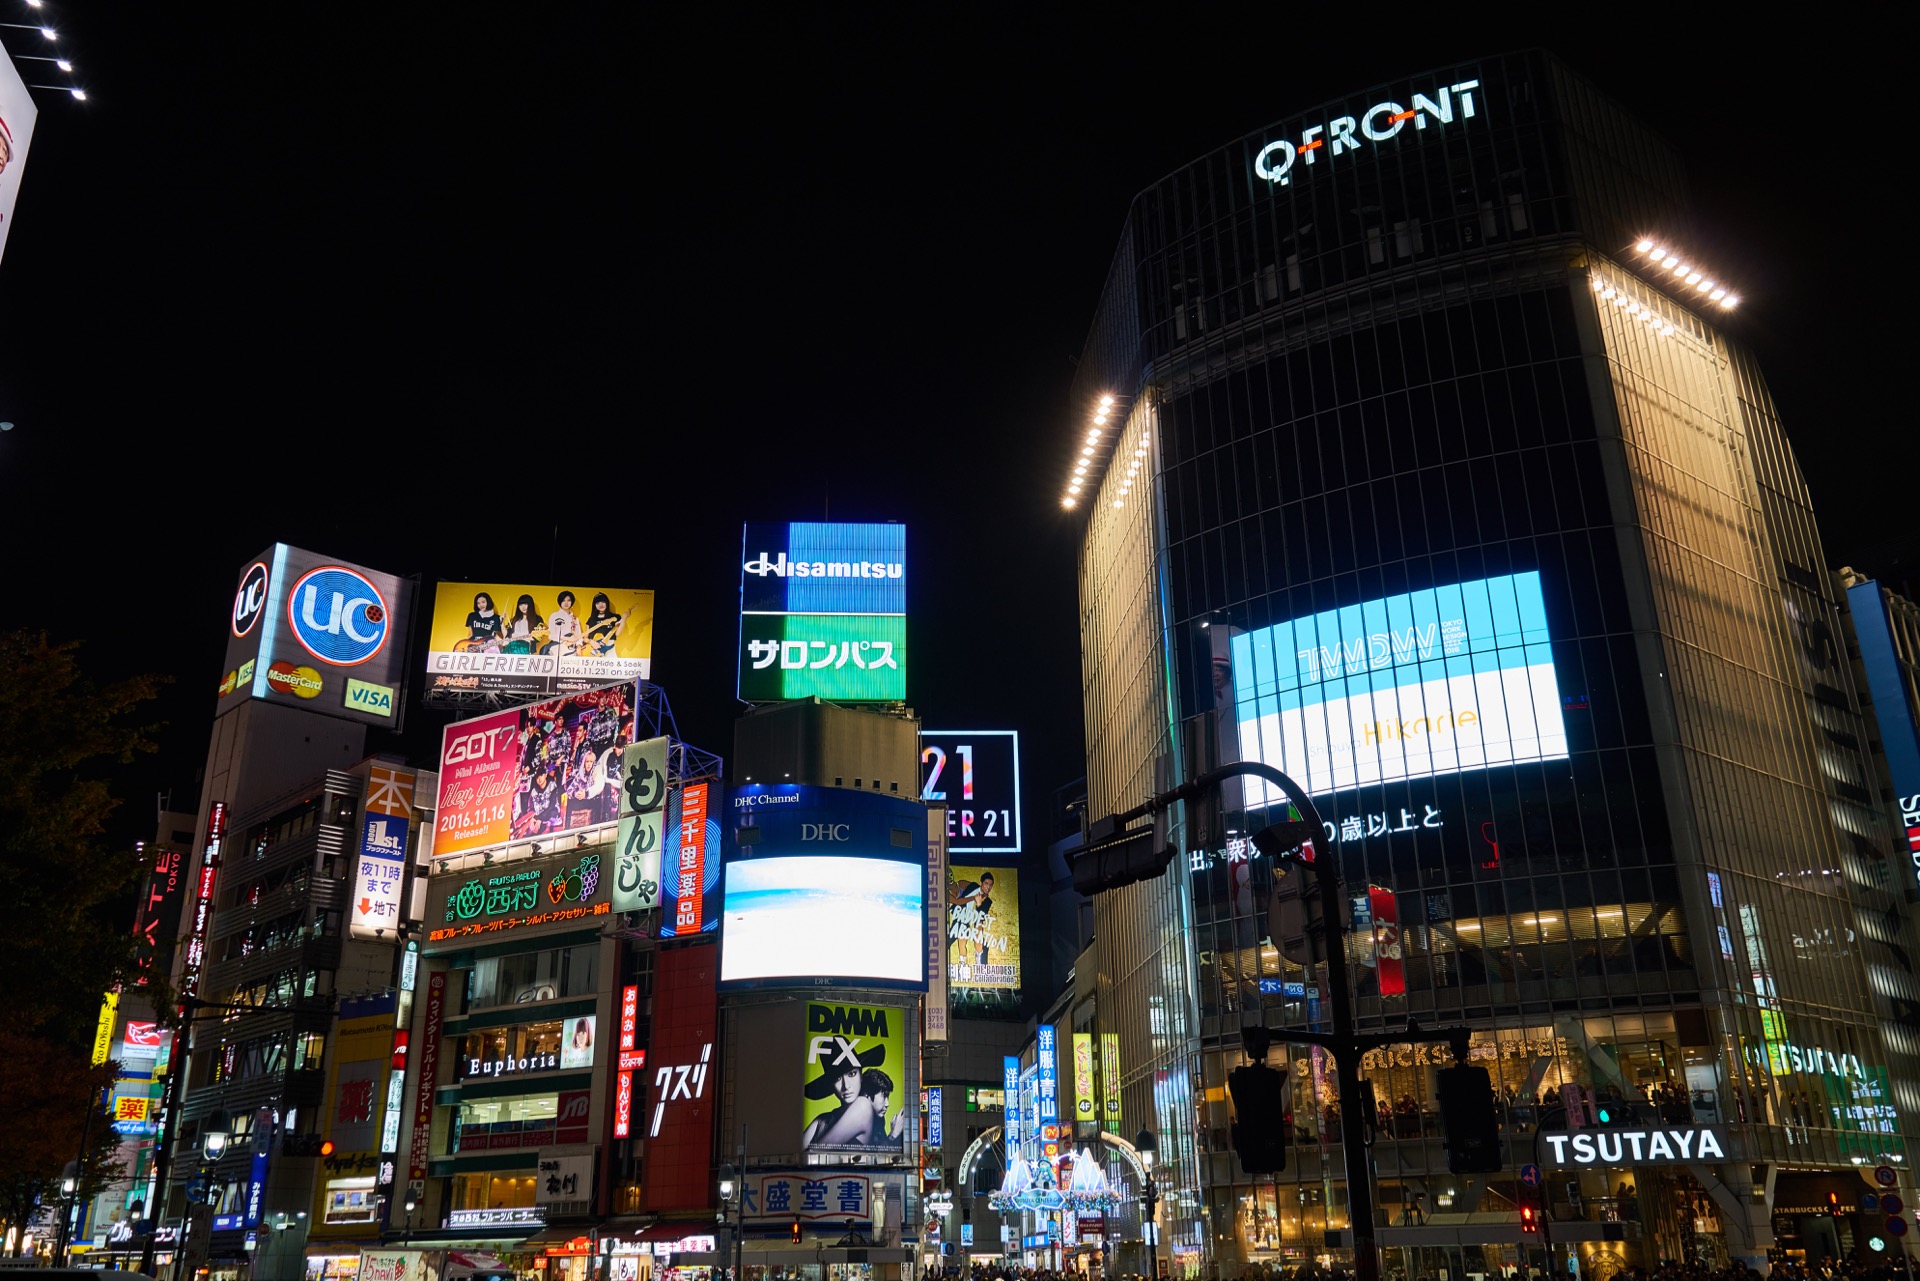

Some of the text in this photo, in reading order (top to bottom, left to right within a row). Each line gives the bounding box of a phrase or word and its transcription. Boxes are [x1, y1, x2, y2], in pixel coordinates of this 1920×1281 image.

[1254, 79, 1479, 186] QFRONT
[744, 552, 902, 578] Hisamitsu
[1441, 619, 1463, 628] OKYO
[436, 655, 554, 673] GIRLFRIEND
[748, 639, 897, 670] サロンパス
[1298, 622, 1436, 682] TWDW
[239, 664, 253, 680] VISA
[268, 669, 323, 690] MasterCard
[560, 667, 606, 675] 2016.11.23
[624, 668, 642, 676] sale
[352, 688, 391, 709] VISA
[1364, 708, 1477, 747] Hikarie
[444, 727, 516, 765] GOT7
[455, 761, 500, 780] Mini Album
[920, 745, 974, 800] 21
[366, 770, 413, 815] 本
[440, 770, 511, 810] Hey Yah
[734, 793, 800, 808] DHC Channel
[440, 804, 506, 833] 2016.11.16
[617, 757, 664, 904] もんじゃ
[984, 810, 1010, 837] 21
[367, 822, 376, 843] BOOK
[454, 824, 489, 841] Release!!
[801, 824, 850, 842] DHC
[366, 845, 402, 856] ブックファースト
[677, 790, 701, 926] 三千里薬品
[166, 853, 181, 893] TOKYO
[361, 862, 401, 881] 夜11時
[489, 870, 541, 886] FRUITS&PARLOR
[367, 878, 392, 895] まで
[486, 882, 539, 916] 西村
[373, 900, 397, 917] 地下
[445, 895, 456, 922] 渋谷
[928, 833, 943, 980] Taisei neon
[952, 905, 997, 931] BADDEST
[949, 922, 1009, 953] ABORATION
[814, 977, 834, 985] DHC
[973, 965, 1016, 976] THE BADDEST
[621, 989, 636, 1047] お好み焼
[808, 1004, 890, 1039] DMM
[927, 1015, 944, 1023] 3719
[928, 1007, 944, 1016] (03)
[339, 1023, 395, 1037] Matsumoto KiYos
[927, 1022, 945, 1030] 2468
[420, 999, 440, 1113] ウィンターフルーツギフト
[807, 1036, 861, 1068] FX
[1778, 1044, 1863, 1079] TSUTAYA
[469, 1054, 556, 1077] Euphoria
[1039, 1030, 1056, 1117] 洋服の青山
[650, 1043, 713, 1138] クスリ
[119, 1098, 145, 1119] 薬
[560, 1096, 589, 1121] JTB
[616, 1073, 630, 1136] もんじゃ焼
[931, 1090, 940, 1144] 大盛堂商事ビル
[1005, 1067, 1020, 1160] 洋服の青山
[1079, 1101, 1091, 1111] 4F
[1546, 1129, 1724, 1164] TSUTAYA
[248, 1182, 261, 1220] みずほ銀行
[1774, 1205, 1856, 1214] STARBUCKS CFEE
[482, 1210, 534, 1222] フルーツパーラー
[363, 1254, 377, 1280] 15
